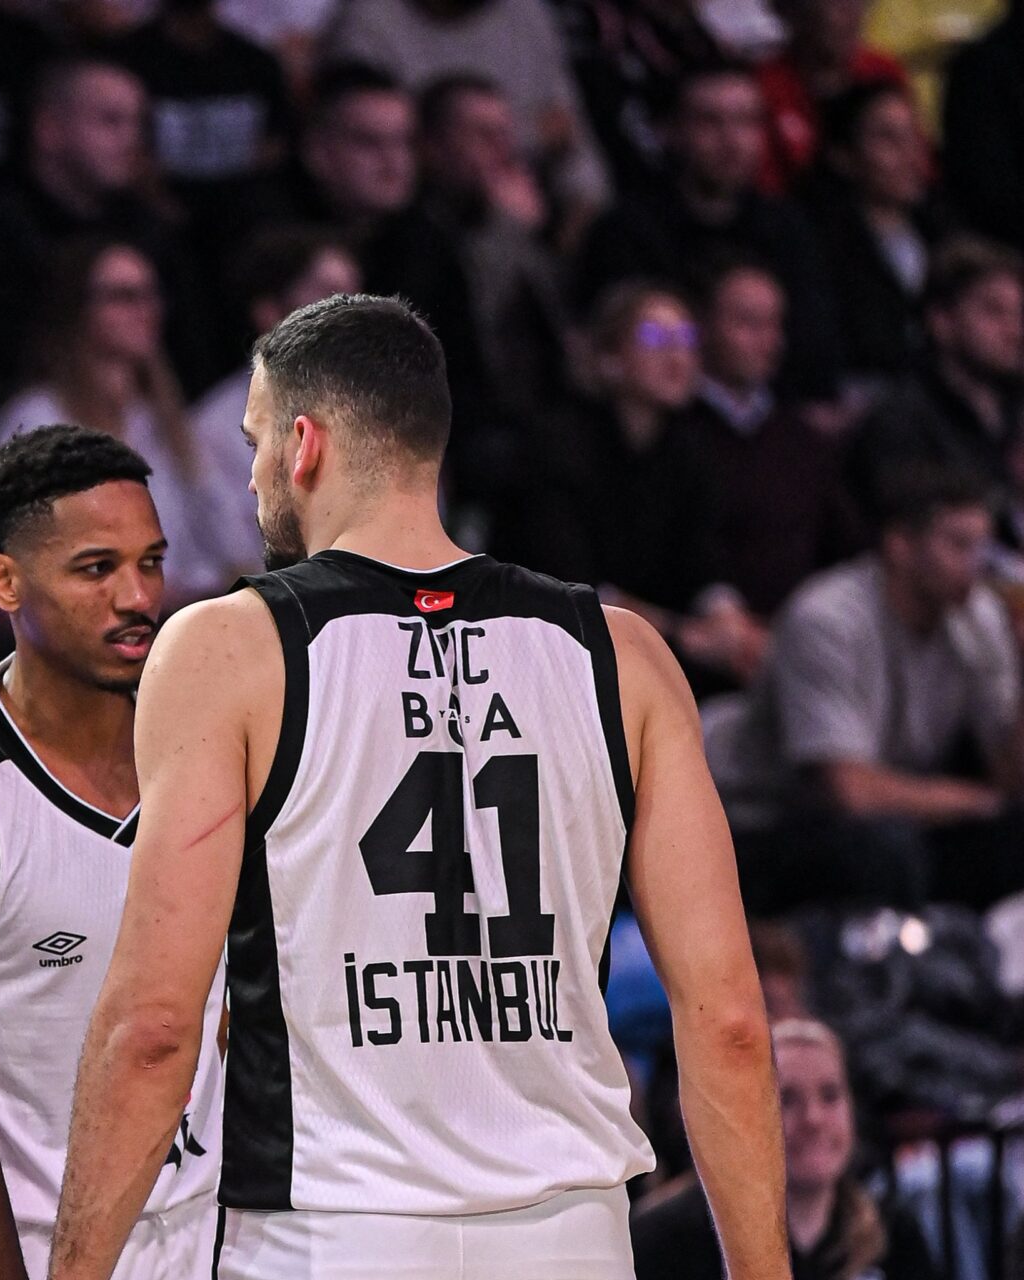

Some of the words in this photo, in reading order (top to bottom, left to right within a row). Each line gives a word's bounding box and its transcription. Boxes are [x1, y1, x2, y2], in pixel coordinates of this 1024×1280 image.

[397, 621, 490, 685] ZIIC
[358, 750, 556, 959] 41
[39, 954, 83, 968] umbro
